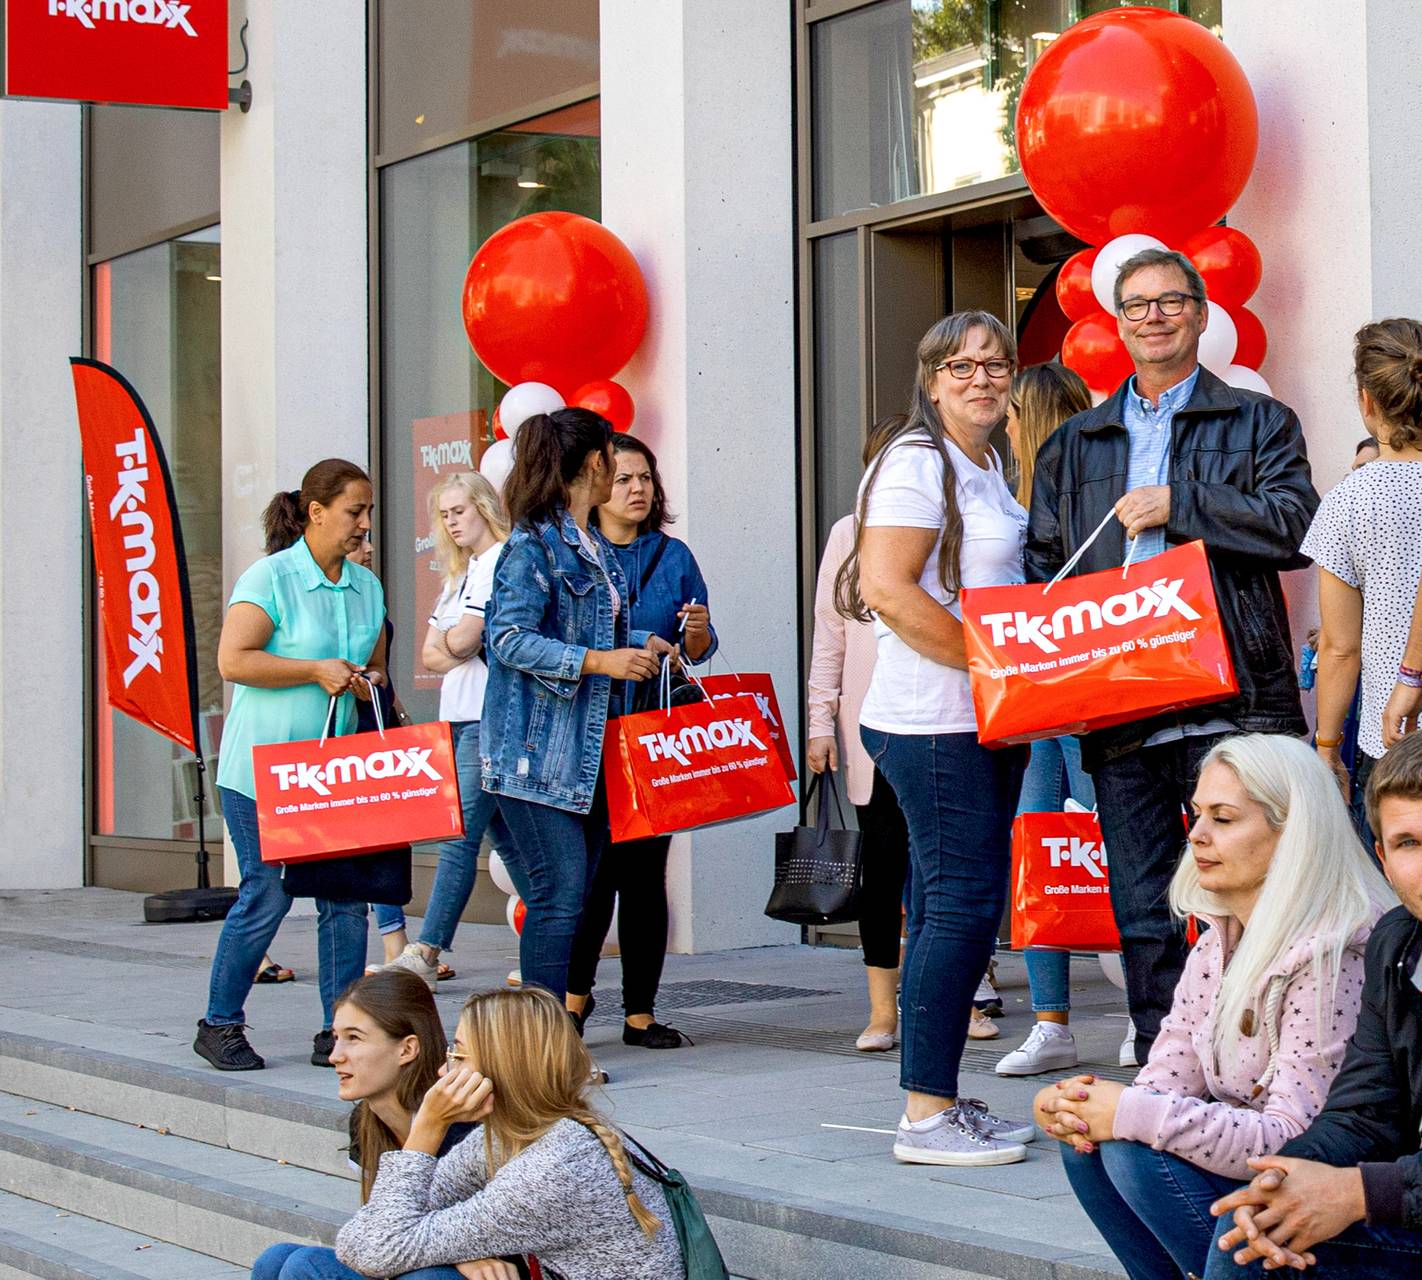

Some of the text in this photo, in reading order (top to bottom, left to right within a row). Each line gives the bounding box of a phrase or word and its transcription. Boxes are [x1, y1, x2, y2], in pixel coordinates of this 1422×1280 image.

[989, 665, 1018, 679] Große
[1020, 660, 1057, 674] Marken
[1059, 653, 1090, 666] immer
[1091, 648, 1107, 659] bis
[1108, 646, 1121, 656] zu
[1121, 640, 1135, 652] 60
[1136, 638, 1148, 650] %
[651, 776, 670, 787] Große
[669, 772, 693, 783] Marken
[692, 768, 711, 778] immer
[711, 765, 721, 775] bis
[728, 762, 737, 771] 60
[275, 805, 299, 815] Große
[299, 802, 329, 811] Marken
[330, 799, 355, 807] immer
[356, 796, 368, 804] bis
[380, 793, 390, 801] 60
[392, 791, 400, 799] %
[1044, 885, 1069, 894] Große
[1071, 884, 1101, 893] Marken
